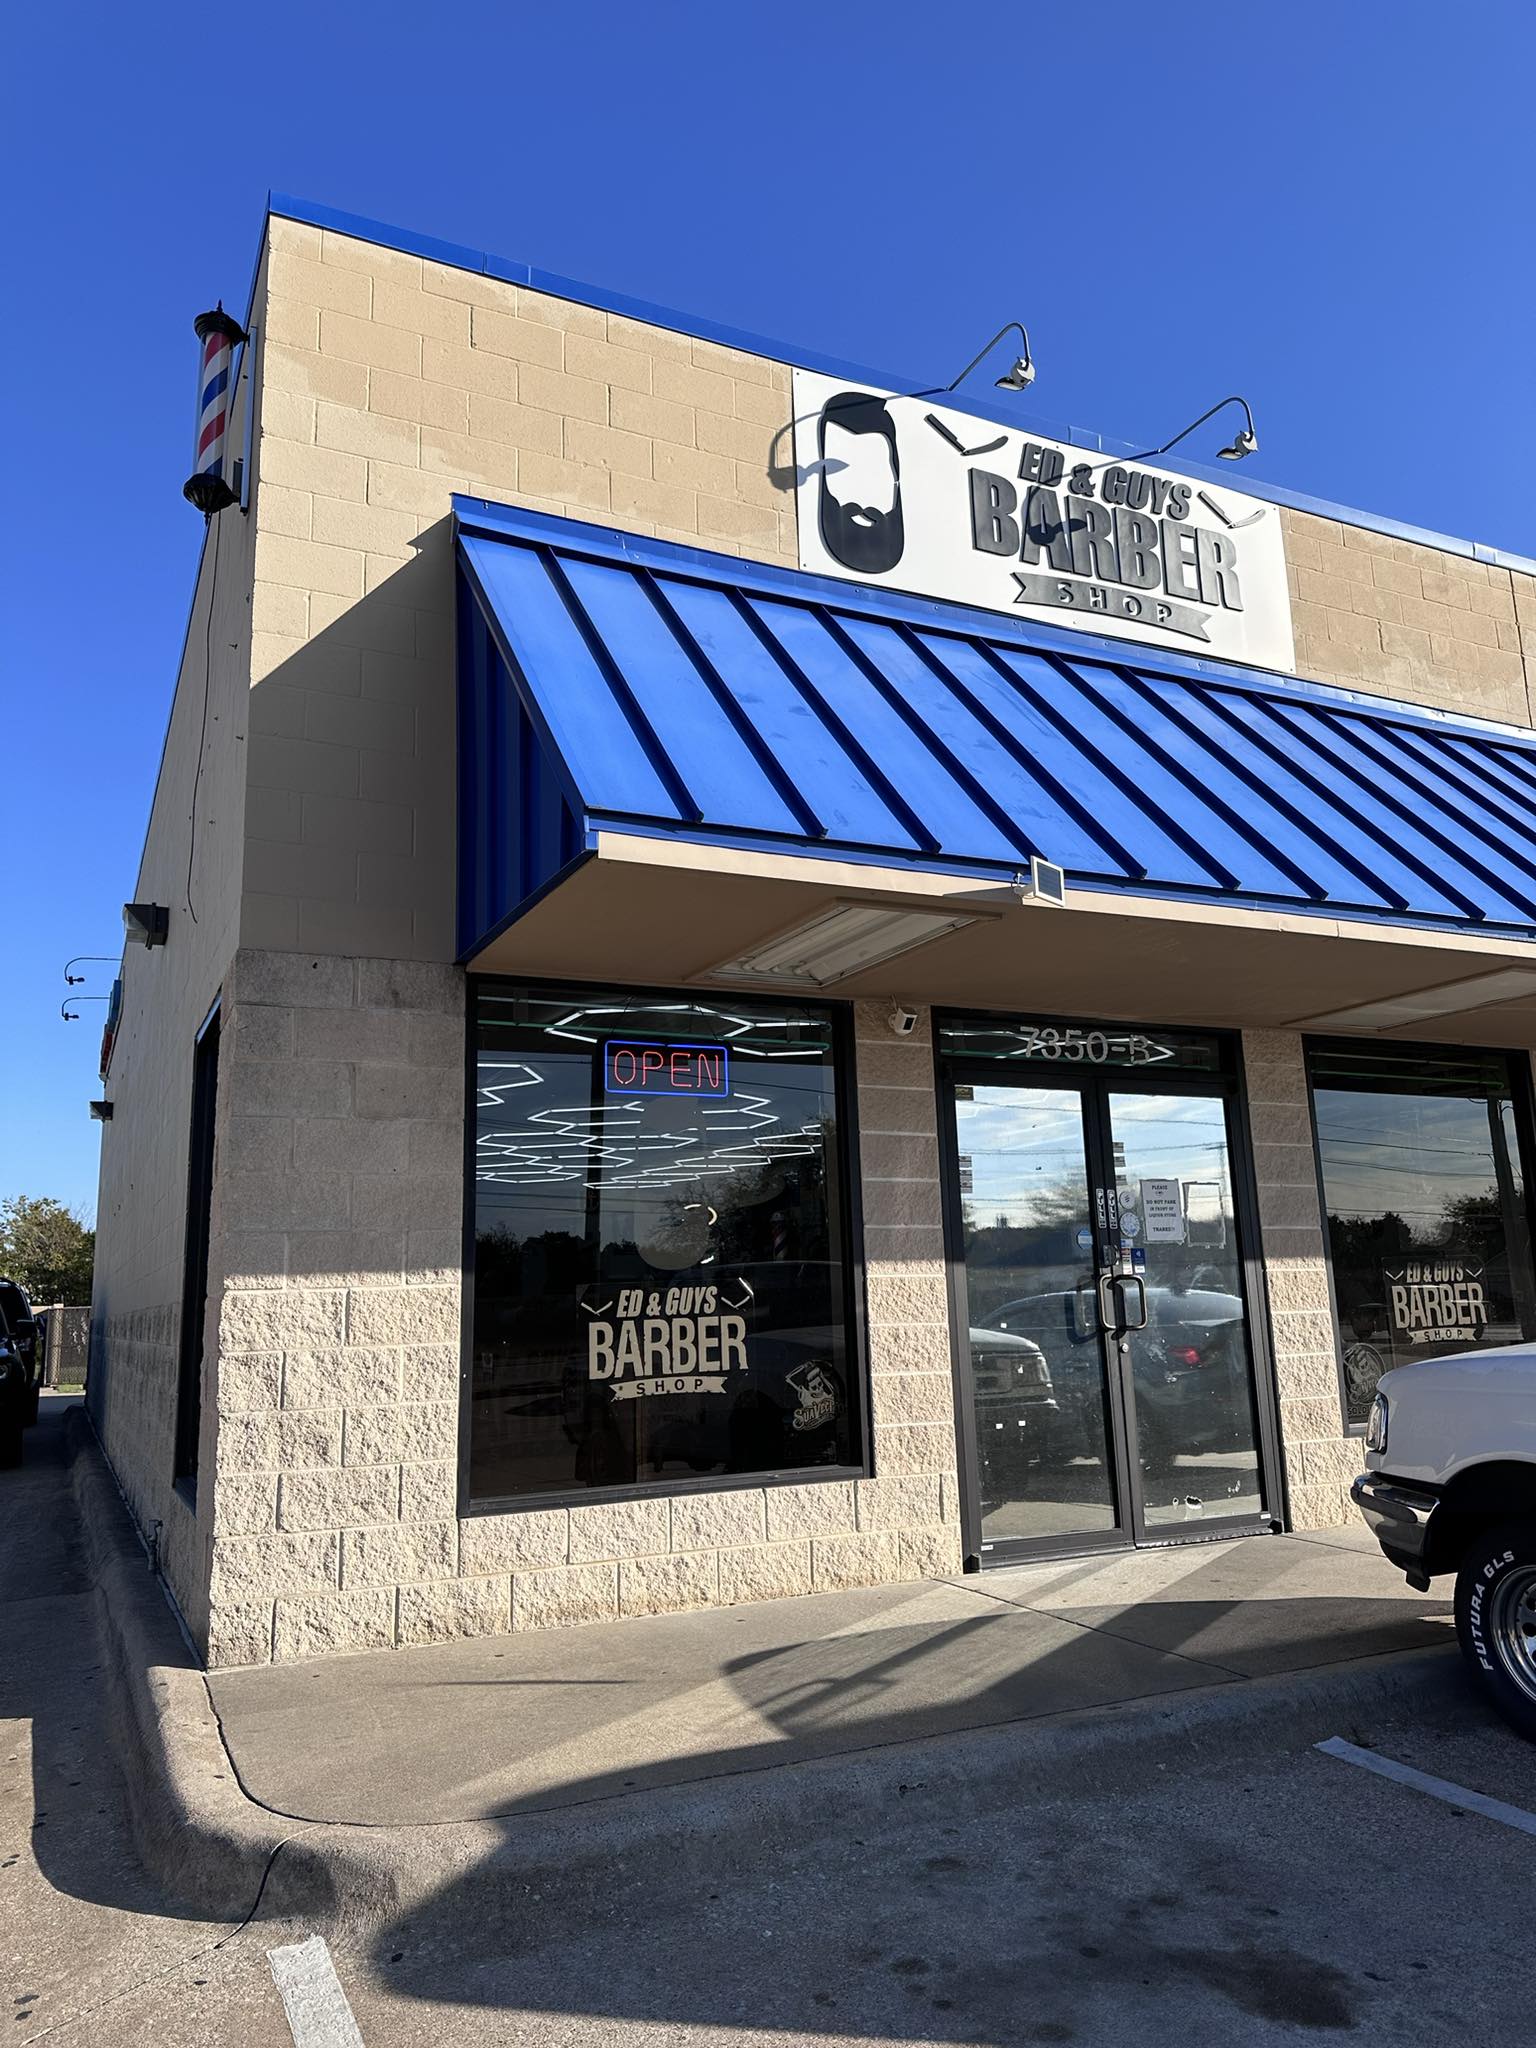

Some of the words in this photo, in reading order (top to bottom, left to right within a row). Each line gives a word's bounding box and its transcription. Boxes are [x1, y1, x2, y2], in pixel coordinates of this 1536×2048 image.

[1017, 442, 1065, 487] ED
[1067, 463, 1096, 497] &
[1100, 466, 1192, 520] GUYS
[967, 467, 1244, 612] BARBER
[1057, 581, 1172, 622] SHOP
[1020, 1026, 1150, 1065] 7350-B
[614, 1050, 719, 1088] OPEN
[1097, 1192, 1105, 1219] PULL
[1108, 1193, 1116, 1220] PULL
[1406, 1262, 1421, 1283] ED
[1423, 1264, 1432, 1283] &
[1434, 1261, 1464, 1282] GUYS
[616, 1289, 644, 1318] ED
[645, 1292, 662, 1317] &
[665, 1285, 718, 1316] GUYS
[1391, 1282, 1488, 1329] BARBER
[588, 1315, 749, 1380] BARBER
[1423, 1329, 1463, 1341] SHOP
[636, 1378, 703, 1395] SHOP
[1483, 1550, 1515, 1579] GLS
[1470, 1583, 1494, 1671] FUTURA
